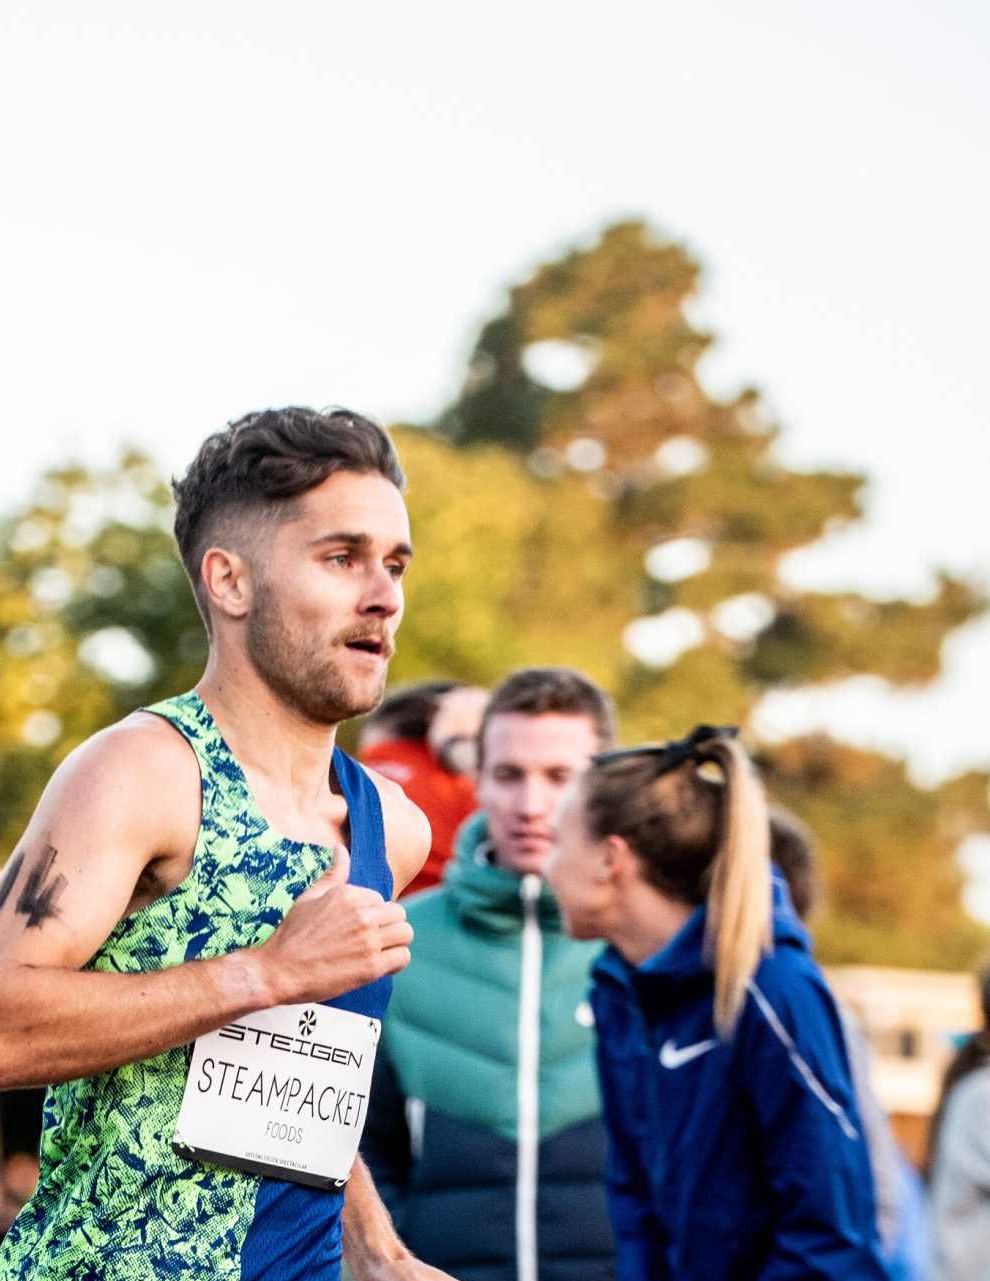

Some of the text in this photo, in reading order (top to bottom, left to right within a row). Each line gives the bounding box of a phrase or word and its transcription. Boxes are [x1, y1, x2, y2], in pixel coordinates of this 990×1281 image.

[218, 1023, 364, 1069] STEIGEN
[196, 1057, 367, 1129] STEAMPACKET
[264, 1120, 305, 1145] FOODS
